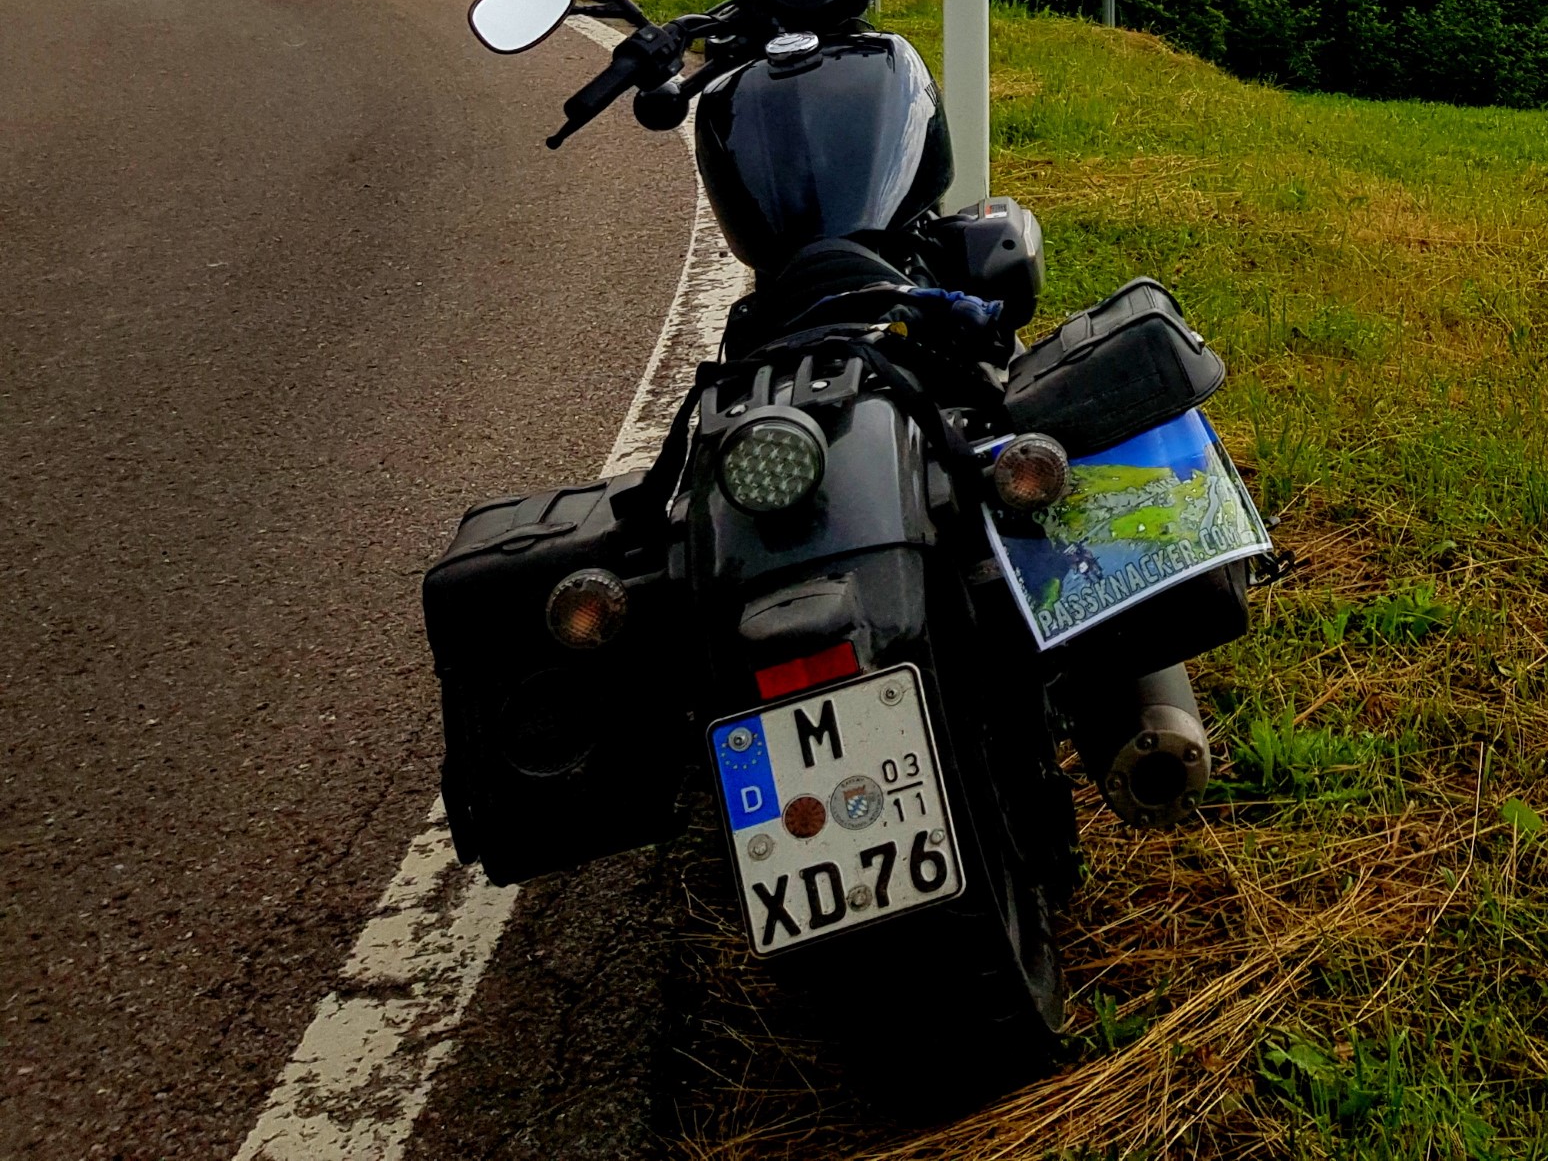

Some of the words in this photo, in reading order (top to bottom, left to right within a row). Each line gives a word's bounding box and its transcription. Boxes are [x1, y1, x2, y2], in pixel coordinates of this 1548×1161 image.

[1036, 523, 1241, 639] PASSKNACKER.COM
[793, 698, 844, 769] M
[881, 752, 920, 784] 03
[740, 784, 764, 814] D
[892, 790, 927, 823] 11
